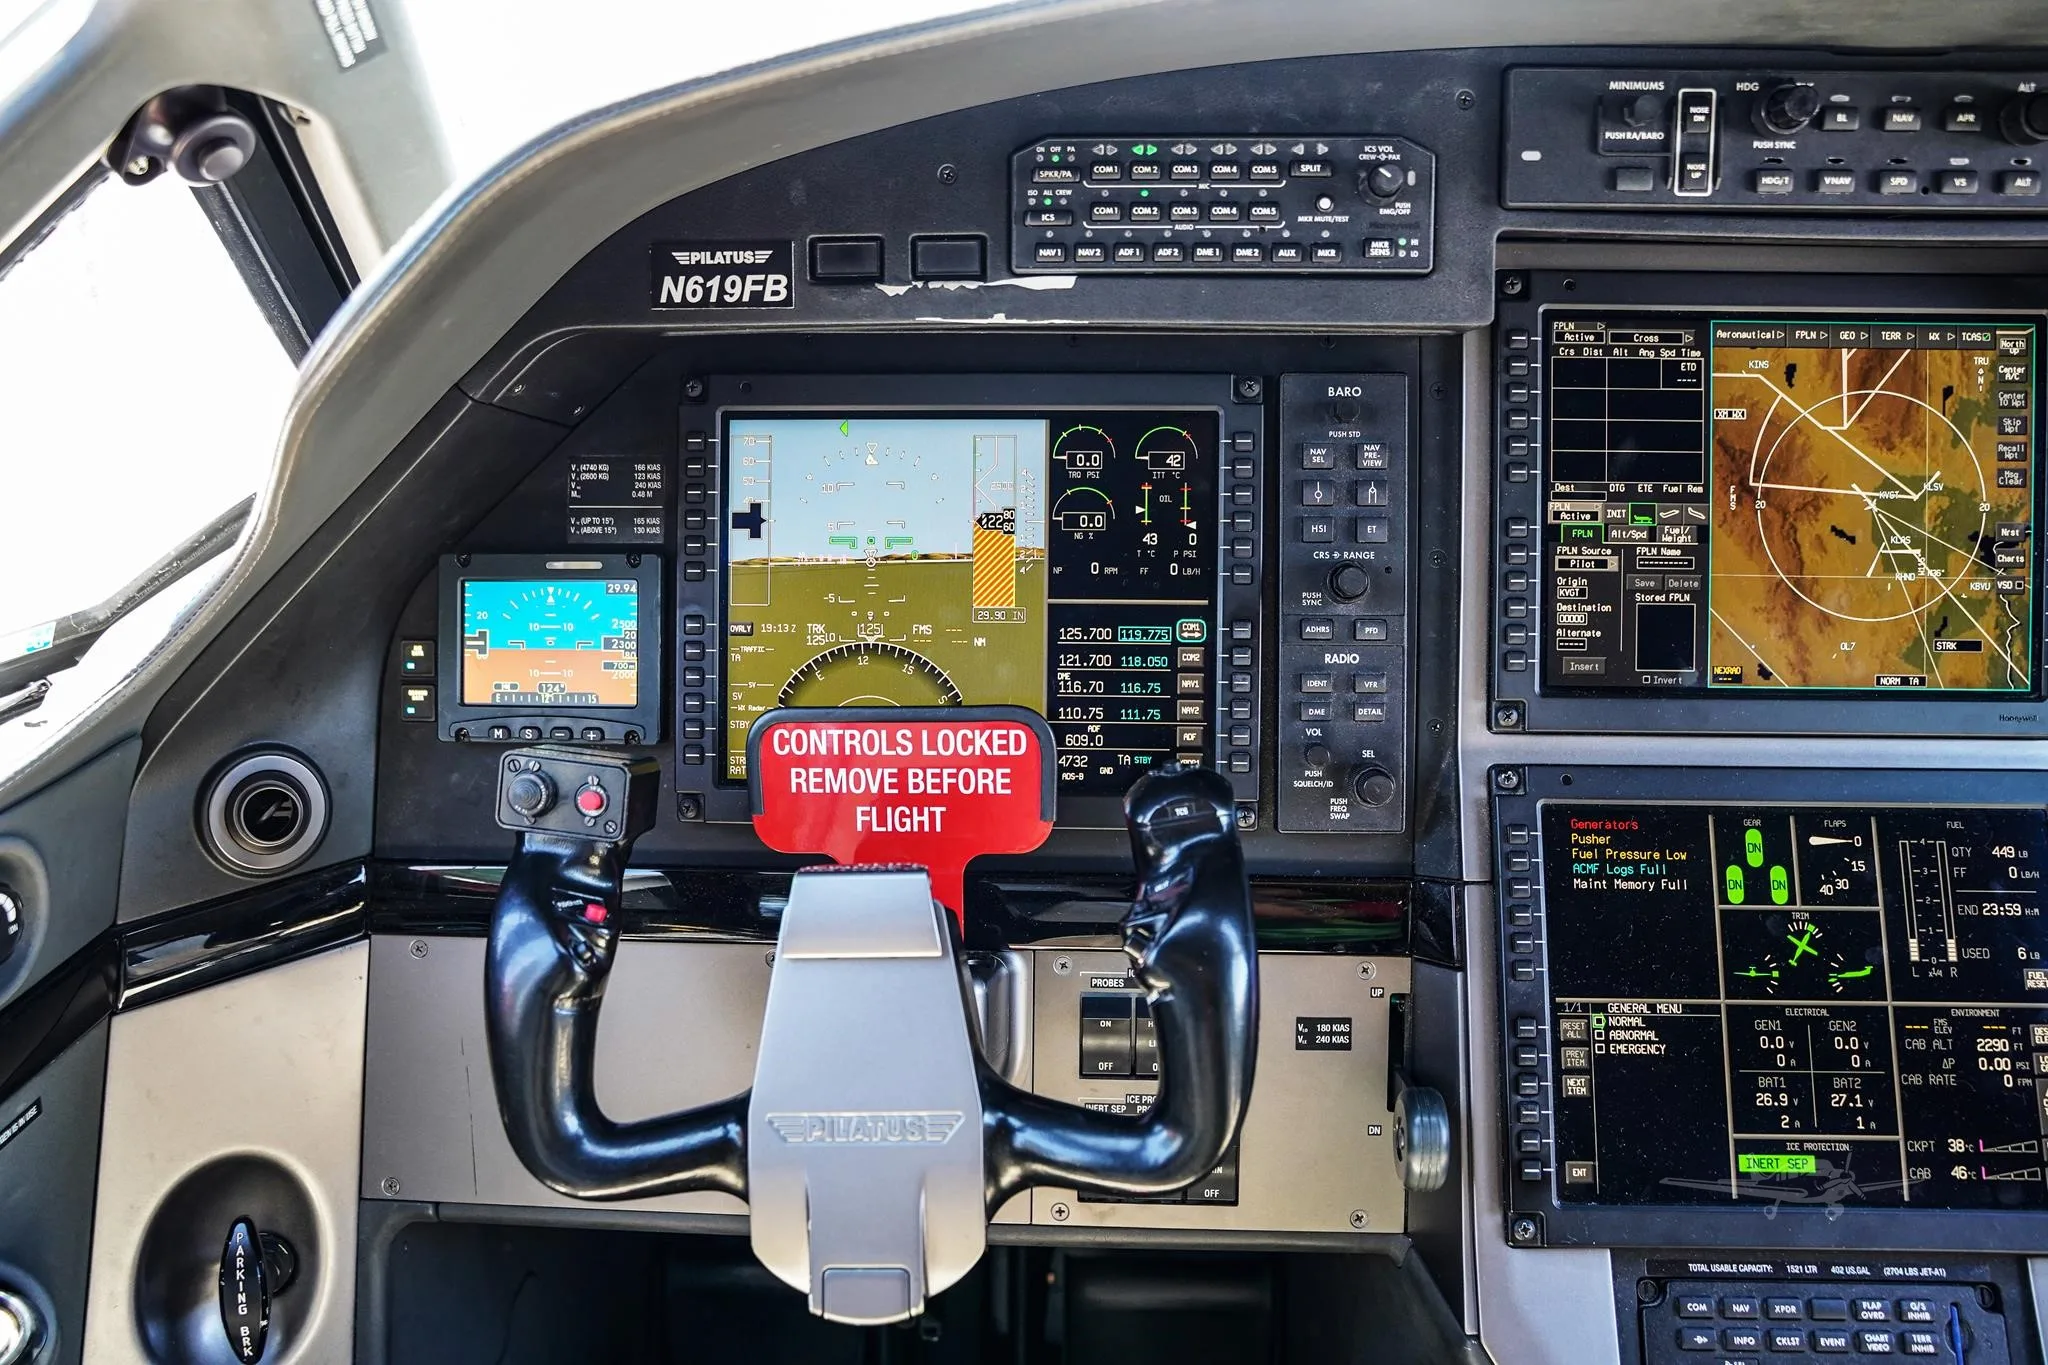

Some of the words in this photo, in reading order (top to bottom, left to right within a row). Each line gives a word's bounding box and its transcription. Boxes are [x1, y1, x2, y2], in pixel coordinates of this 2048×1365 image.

[1609, 81, 1664, 91] MINIMUMS
[1736, 82, 1759, 92] HDG
[1690, 106, 1709, 115] NOSE
[1892, 113, 1914, 122] NAV
[1605, 131, 1625, 140] PUSH
[1626, 131, 1664, 141] RA/BARO
[1753, 141, 1773, 149] PUSH
[1774, 141, 1796, 149] SYNC
[1300, 164, 1322, 173] SPLIT
[1039, 170, 1072, 180] SPKR/PA
[1761, 176, 1789, 186] HDG/T
[1824, 176, 1851, 185] VNAV
[1041, 214, 1055, 222] ICS
[691, 251, 754, 264] PILATUS
[1278, 249, 1296, 258] AUX
[1318, 249, 1336, 258] MKR
[660, 274, 788, 303] N619FB
[1565, 333, 1594, 341] Active
[1634, 334, 1659, 342] Cross
[1717, 330, 1774, 339] Aeronautical
[1795, 331, 1816, 340] FPLN
[1840, 331, 1856, 340] GEO
[1882, 332, 1901, 340] TERR
[1929, 332, 1940, 341] WX
[1962, 332, 1982, 341] TCAS
[1559, 348, 1575, 356] Crs
[1583, 348, 1602, 356] Dist
[1613, 348, 1628, 356] Alt
[1639, 349, 1655, 357] Ang
[1660, 349, 1675, 357] Spd
[1328, 387, 1362, 397] BARO
[1077, 454, 1100, 466] 0.0
[1755, 500, 1766, 509] 20
[1979, 503, 1990, 511] 20
[1560, 512, 1590, 520] Active
[1607, 510, 1626, 518] INIT
[1080, 515, 1103, 527] 0.0
[1572, 530, 1593, 538] FPLN
[1612, 530, 1647, 539] Alt/Spd
[1142, 533, 1158, 545] 43
[1314, 551, 1329, 559] CRS
[1344, 551, 1375, 559] RANGE
[1582, 547, 1612, 555] Source
[1570, 560, 1594, 568] Pilot
[1557, 577, 1587, 586] Origin
[608, 584, 637, 593] 29.94
[1557, 604, 1612, 612] Destination
[1059, 628, 1112, 639] 125.700
[1121, 630, 1168, 640] 119.775
[1557, 629, 1601, 637] Alternate
[1937, 642, 1956, 650] STRK
[1059, 655, 1111, 666] 121.700
[1121, 656, 1168, 667] 118.050
[1325, 654, 1359, 663] RADIO
[1880, 677, 1901, 685] NORM
[1909, 677, 1919, 685] TA
[1059, 681, 1104, 693] 116.70
[1121, 683, 1161, 693] 116.75
[1059, 708, 1104, 719] 110.75
[1120, 710, 1160, 720] 111.75
[494, 729, 502, 739] M
[526, 729, 532, 739] S
[773, 729, 913, 756] CONTROLS
[922, 729, 1027, 756] LOCKED
[1065, 734, 1103, 746] 609.0
[1362, 750, 1375, 758] SEL
[791, 768, 898, 794] REMOVE
[908, 768, 1012, 794] BEFORE
[856, 806, 946, 832] FLIGHT
[1571, 819, 1639, 830] Generators
[1824, 820, 1846, 828] FLAPS
[1572, 835, 1610, 845] Pusher
[1573, 850, 1598, 860] Fuel
[1606, 850, 1660, 860] Pressure
[1667, 850, 1686, 860] Low
[1573, 864, 1599, 874] ACMF
[1607, 864, 1634, 875] Logs
[1641, 864, 1666, 874] Full
[1851, 861, 1865, 871] 15
[1574, 879, 1607, 889] Maint
[1614, 879, 1655, 891] Memory
[1661, 879, 1687, 890] Full
[1835, 879, 1849, 890] 30
[1820, 884, 1833, 895] 40
[1091, 979, 1124, 987] PROBES
[1371, 988, 1383, 997] UP
[1608, 1003, 1652, 1013] GENERAL
[1657, 1004, 1682, 1013] MENU
[1609, 1017, 1646, 1027] NORMAL
[1754, 1020, 1782, 1031] GEN1
[1829, 1021, 1857, 1032] GEN2
[1317, 1024, 1330, 1032] 180
[1332, 1024, 1350, 1032] KIAS
[1316, 1035, 1330, 1043] 240
[1332, 1035, 1349, 1043] KIAS
[1609, 1030, 1658, 1041] ABNORMAL
[1610, 1044, 1666, 1054] EMERGENCY
[1098, 1062, 1113, 1071] OFF
[1758, 1077, 1786, 1088] BAT1
[1833, 1077, 1861, 1089] BAT2
[1756, 1094, 1788, 1106] 26.9
[1831, 1094, 1863, 1107] 27.1
[807, 1115, 928, 1141] PILATUS
[1369, 1126, 1381, 1135] DN
[1204, 1189, 1220, 1198] OFF
[236, 1232, 247, 1315] PARKING
[1687, 1303, 1707, 1312] COM
[1733, 1304, 1750, 1313] NAV
[1774, 1305, 1797, 1314] XPDR
[241, 1326, 253, 1356] BRK
[1734, 1337, 1755, 1345] INFO
[1776, 1337, 1799, 1346] CKLST
[1820, 1338, 1845, 1347] EVENT
